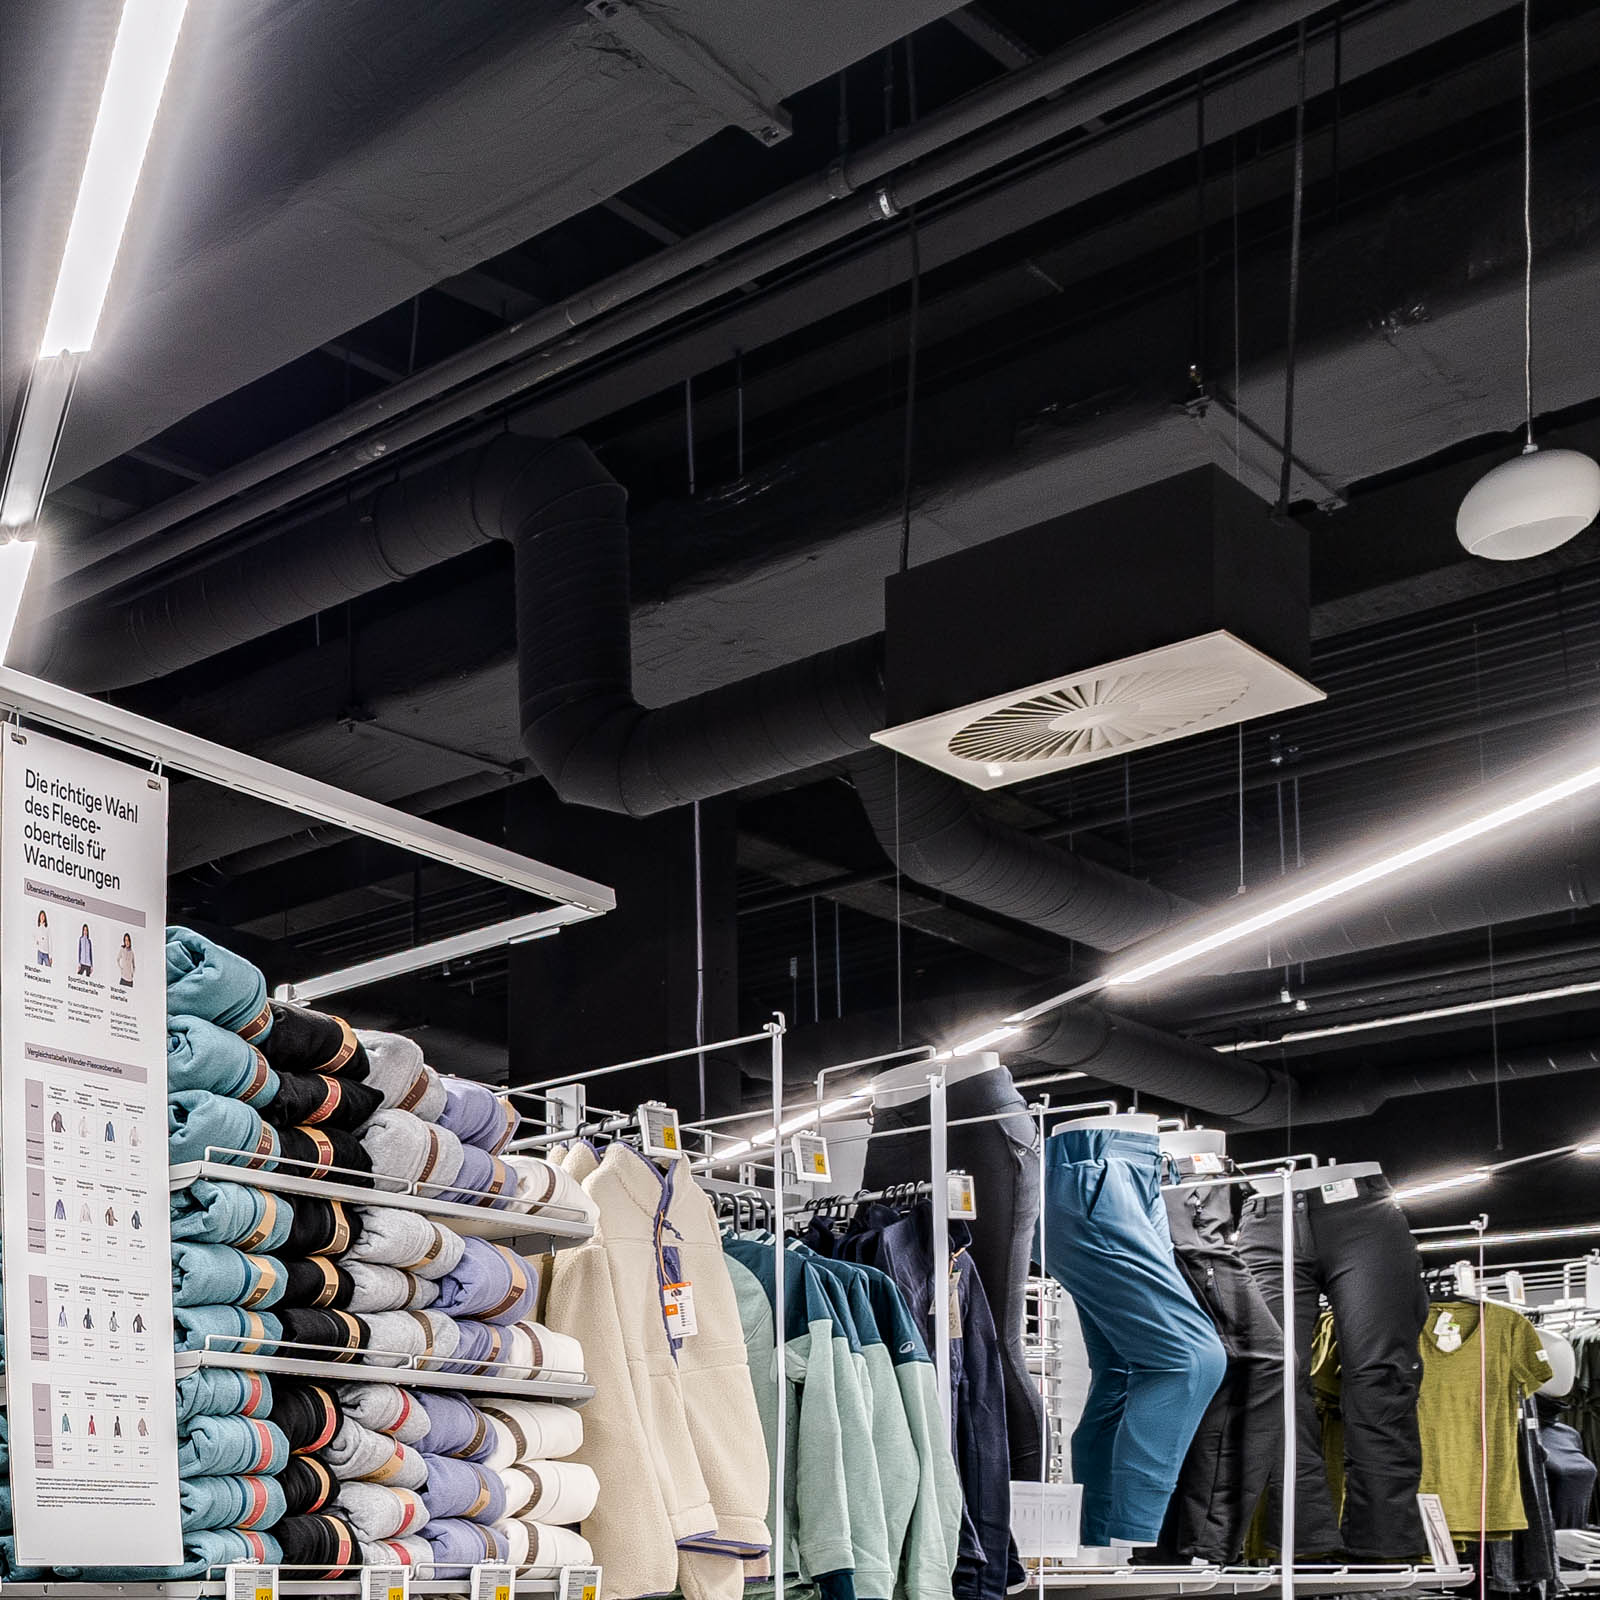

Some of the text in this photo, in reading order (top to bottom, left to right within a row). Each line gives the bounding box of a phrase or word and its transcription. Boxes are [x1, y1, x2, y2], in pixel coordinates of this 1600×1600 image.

[25, 768, 138, 823] Die richtige Wahl
[25, 796, 101, 834] des Fleece-
[24, 821, 106, 861] oberteils für
[24, 843, 120, 890] Wanderungen
[26, 881, 49, 896] Übersicht
[27, 1047, 68, 1064] Vergleichstabelle
